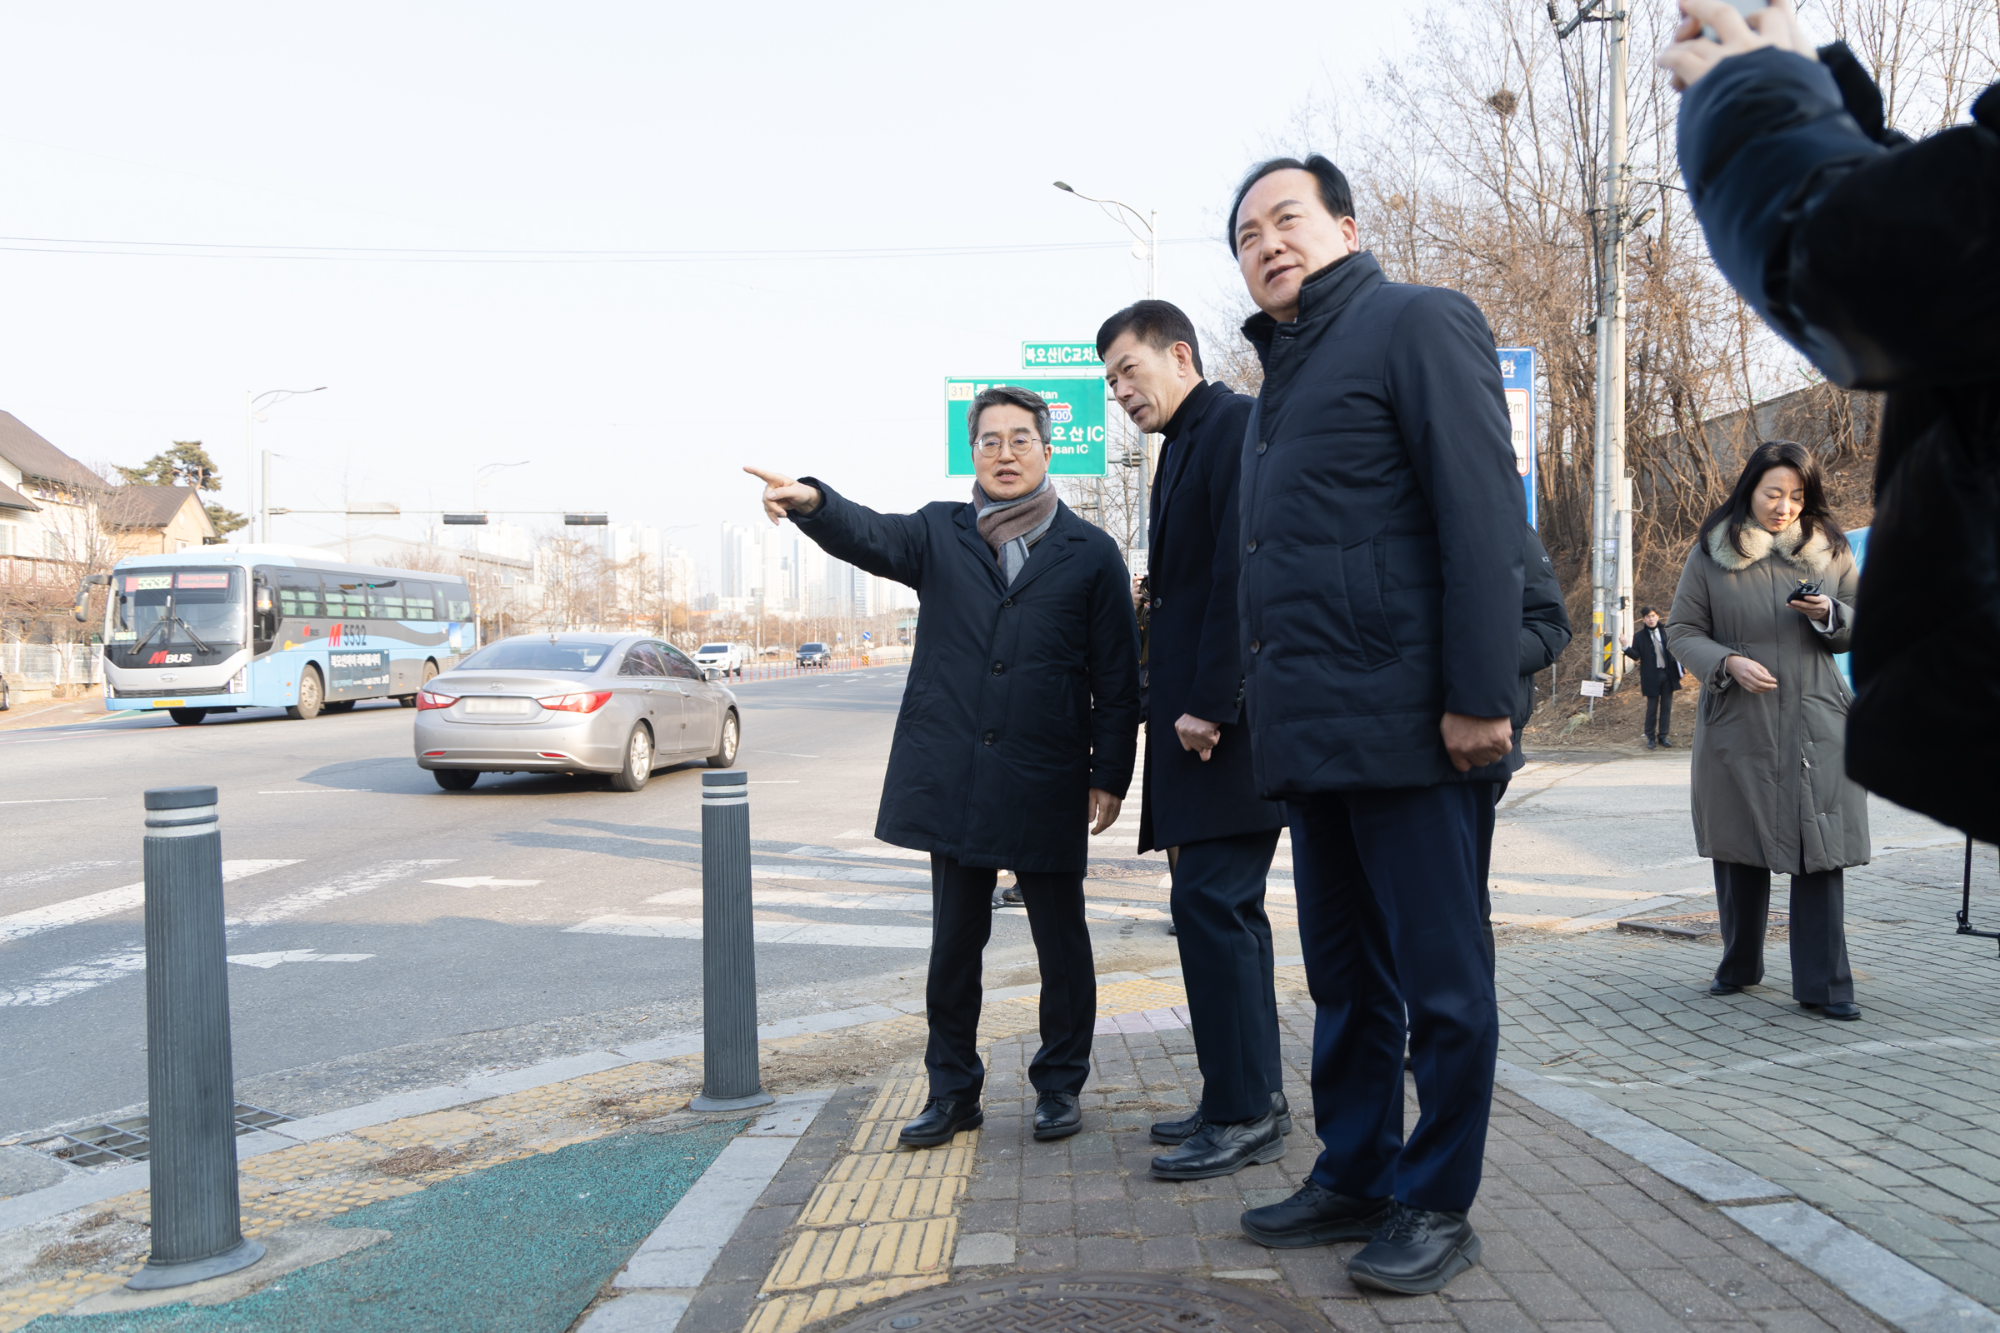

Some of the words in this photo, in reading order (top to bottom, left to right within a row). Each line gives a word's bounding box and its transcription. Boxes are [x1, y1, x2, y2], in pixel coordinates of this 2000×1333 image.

[951, 386, 971, 396] 317
[1050, 410, 1068, 420] 400
[1087, 425, 1104, 442] IC
[1076, 444, 1088, 454] IC
